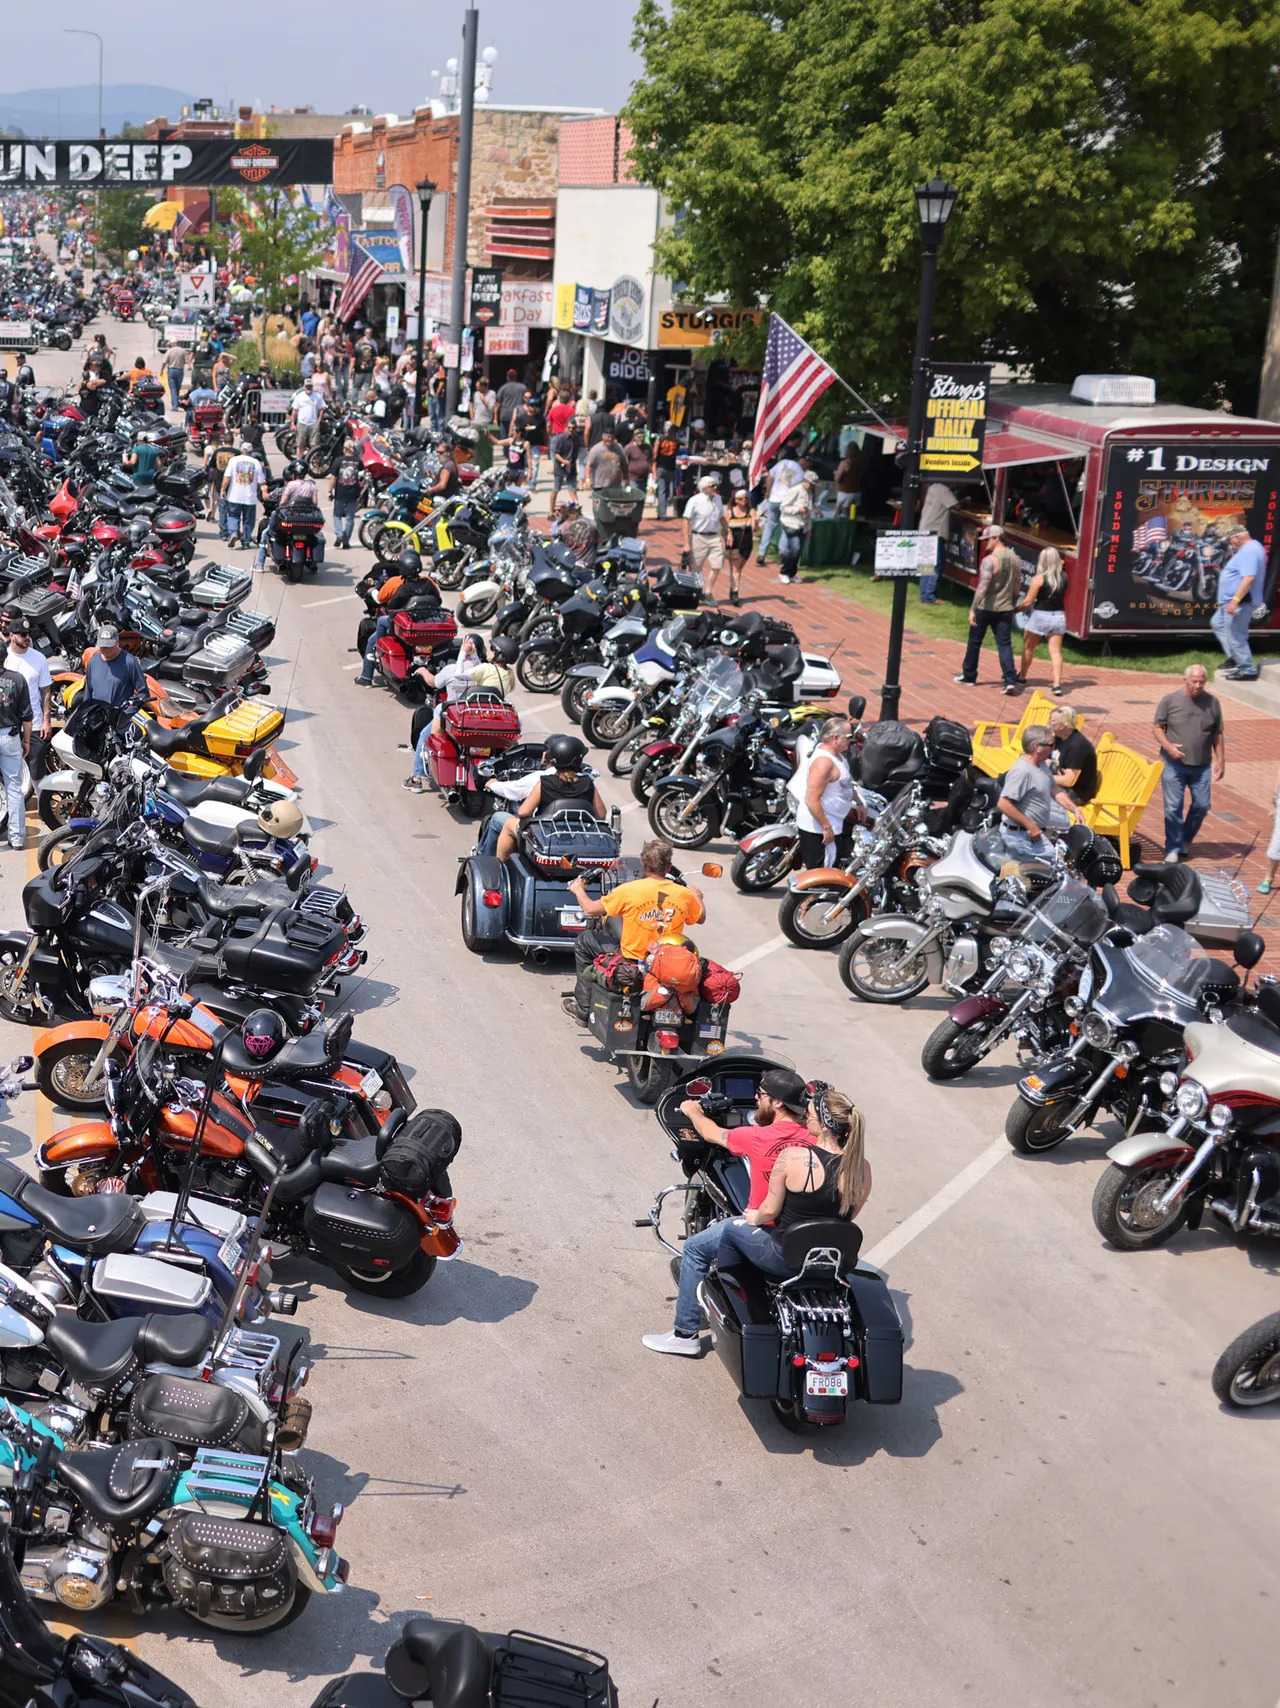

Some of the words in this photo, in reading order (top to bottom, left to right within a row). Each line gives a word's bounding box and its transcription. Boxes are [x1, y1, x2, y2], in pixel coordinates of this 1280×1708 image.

[68, 143, 194, 181] DEEP
[472, 292, 500, 302] DEEP
[513, 307, 542, 322] Day
[930, 376, 986, 401] Sturgis
[927, 398, 986, 419] OFFICIAL
[934, 418, 976, 438] RALLY
[1136, 479, 1257, 512] STURGIS
[1111, 490, 1123, 531] SOLD
[1265, 491, 1277, 531] SOLD
[1107, 534, 1120, 573] HERE
[1263, 534, 1273, 563] HE
[1161, 608, 1205, 616] 2021
